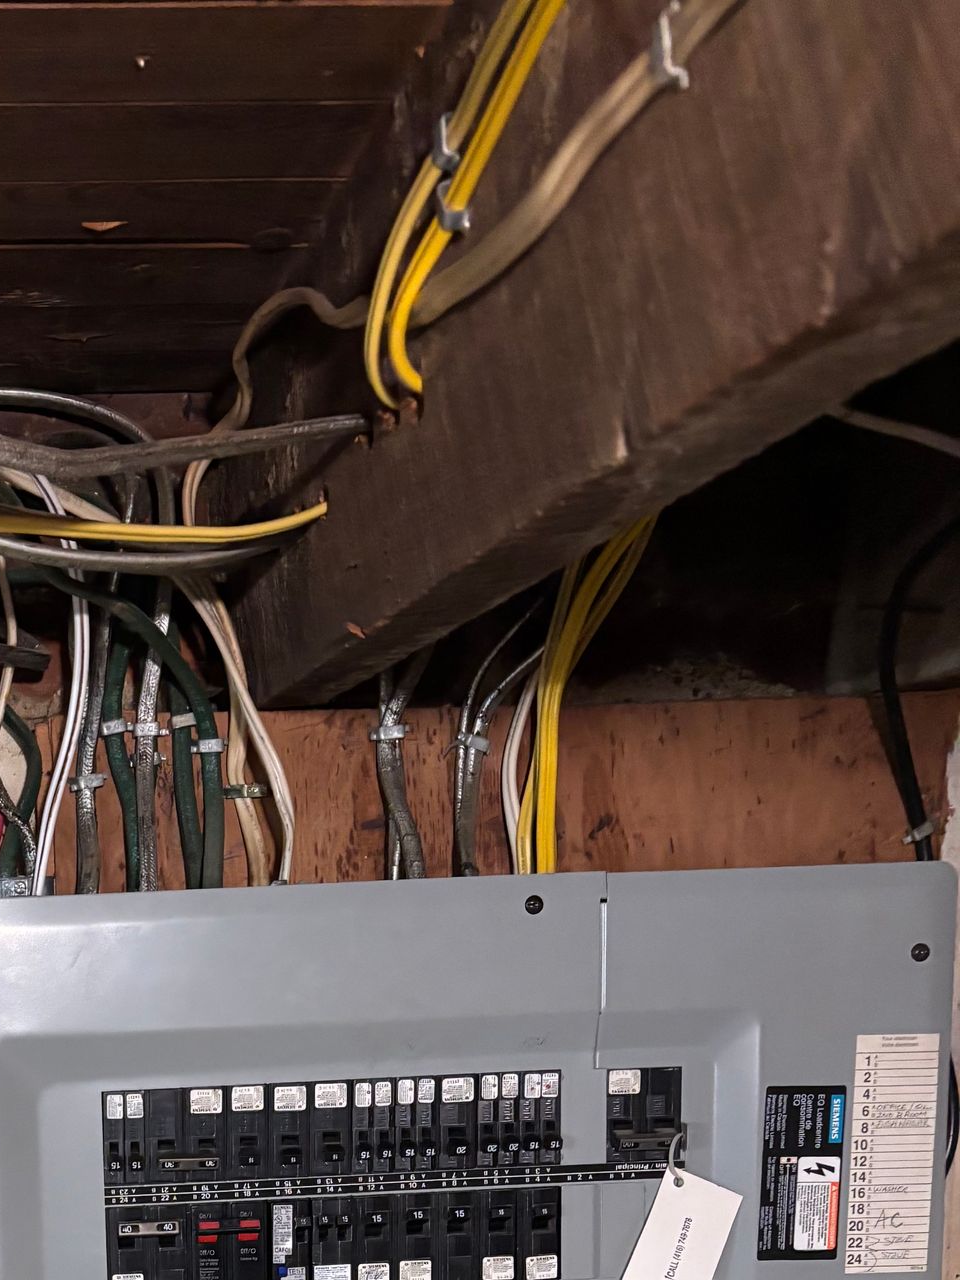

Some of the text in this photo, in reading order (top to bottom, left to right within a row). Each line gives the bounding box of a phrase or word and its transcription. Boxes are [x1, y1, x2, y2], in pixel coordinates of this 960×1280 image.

[865, 1055, 871, 1067] 1
[864, 1072, 871, 1083] 2
[793, 1094, 800, 1106] EQ
[863, 1089, 870, 1100] 4
[805, 1094, 814, 1130] Centre de
[862, 1106, 869, 1117] 6
[798, 1094, 807, 1147] consommation
[814, 1094, 825, 1149] EQ Loadcentre
[831, 1099, 841, 1139] SIEMENS
[861, 1122, 868, 1134] 8
[456, 1146, 466, 1154] 20
[508, 1143, 519, 1151] 20
[529, 1141, 539, 1149] 15
[853, 1139, 868, 1151] 10
[360, 1151, 371, 1159] 15
[405, 1148, 415, 1156] 15
[426, 1148, 435, 1156] 15
[132, 1161, 141, 1169] 15
[853, 1156, 867, 1167] 12
[852, 1172, 866, 1183] 14
[851, 1188, 865, 1199] 16
[850, 1204, 865, 1215] 18
[163, 1223, 173, 1231] 40
[849, 1221, 863, 1231] 20
[848, 1237, 862, 1248] 22
[847, 1254, 862, 1265] 24
